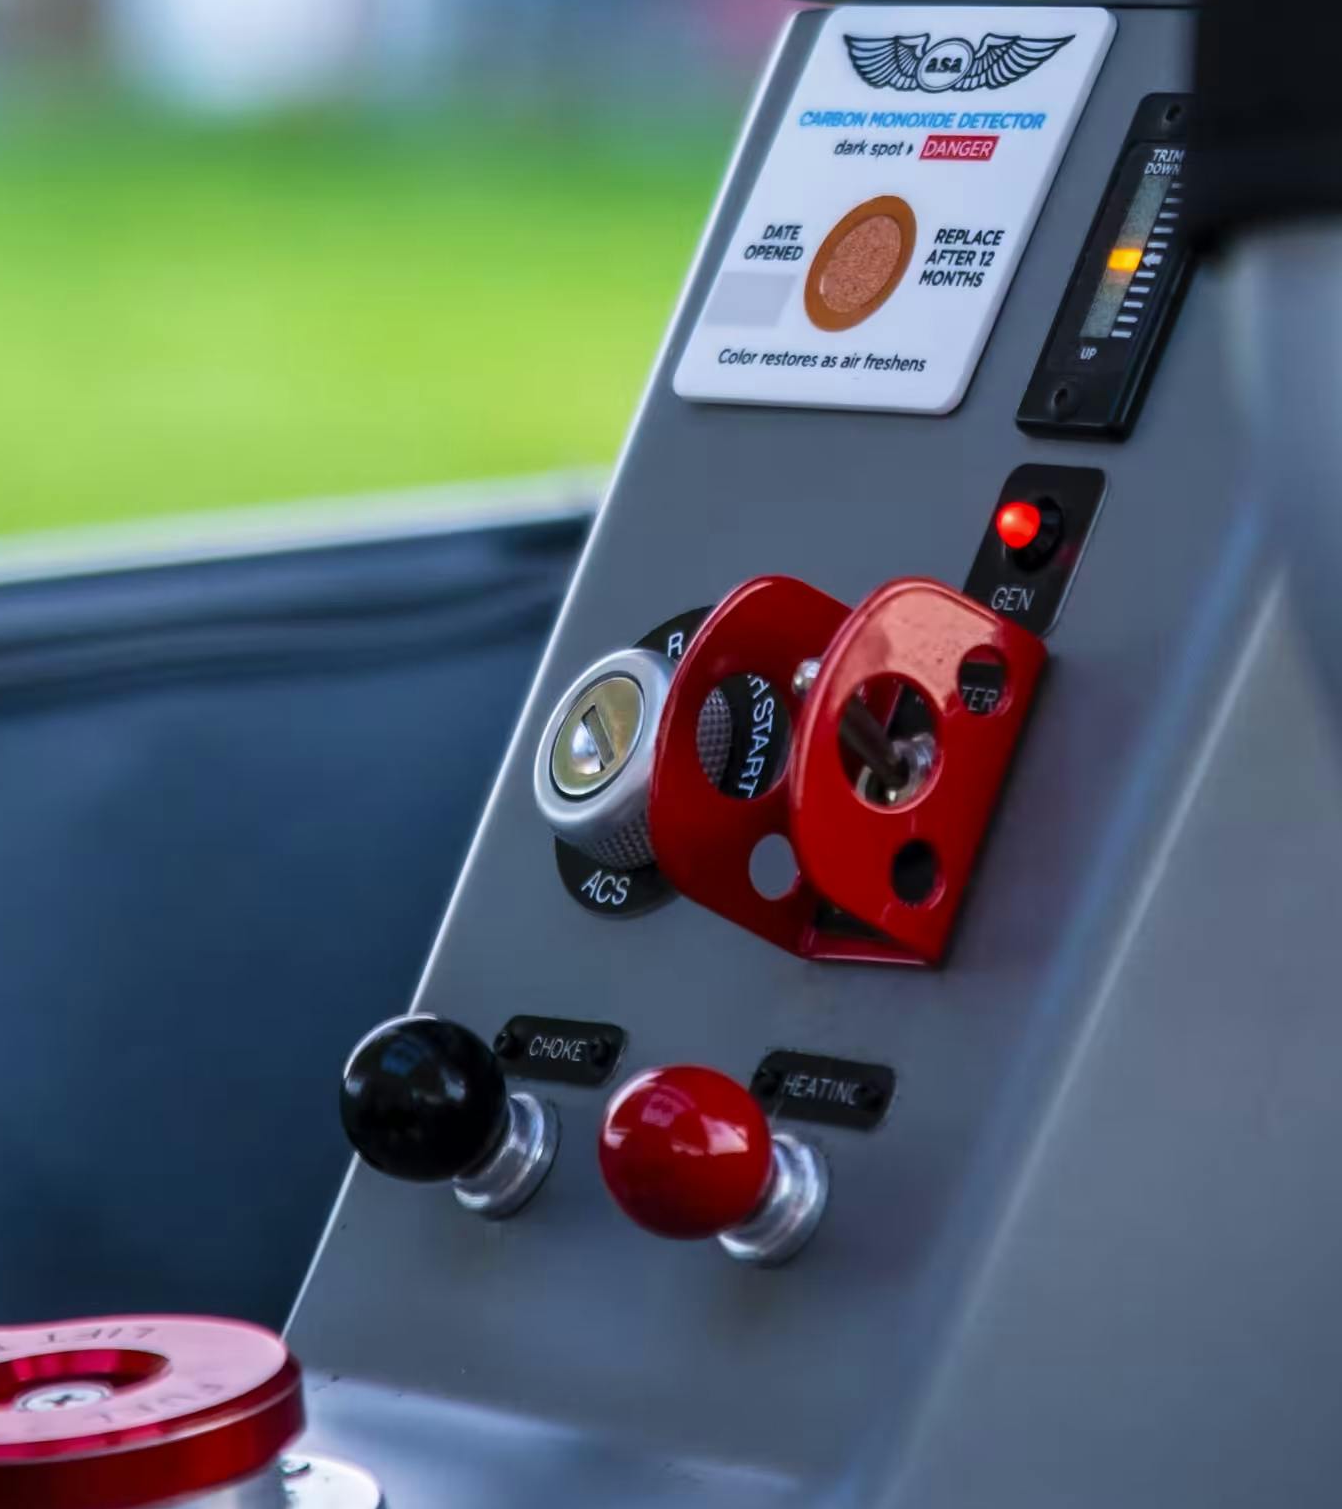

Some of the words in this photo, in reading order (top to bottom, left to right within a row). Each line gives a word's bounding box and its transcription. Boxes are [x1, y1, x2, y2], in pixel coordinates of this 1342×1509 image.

[925, 54, 963, 74] asa
[798, 111, 866, 128] CARBON
[869, 112, 956, 129] MONOXIDE
[959, 112, 1047, 130] DETECTOR
[834, 138, 868, 156] dark
[869, 139, 905, 159] spot
[922, 139, 994, 157] DANGER
[1152, 148, 1185, 163] TRIM
[762, 224, 802, 241] DATE
[933, 228, 1005, 246] REPLACE
[743, 244, 804, 262] OPENED
[924, 249, 977, 267] AFTER
[978, 250, 996, 267] 12
[918, 269, 986, 288] MONTHS
[717, 348, 758, 366] Color
[760, 350, 819, 368] restores
[820, 354, 838, 369] as
[840, 352, 861, 369] air
[862, 353, 927, 372] freshens
[1079, 346, 1098, 360] UP
[990, 585, 1035, 613] GEN
[667, 631, 684, 658] R
[738, 696, 776, 799] START
[580, 869, 631, 907] ACS
[528, 1035, 588, 1063] CHOKE
